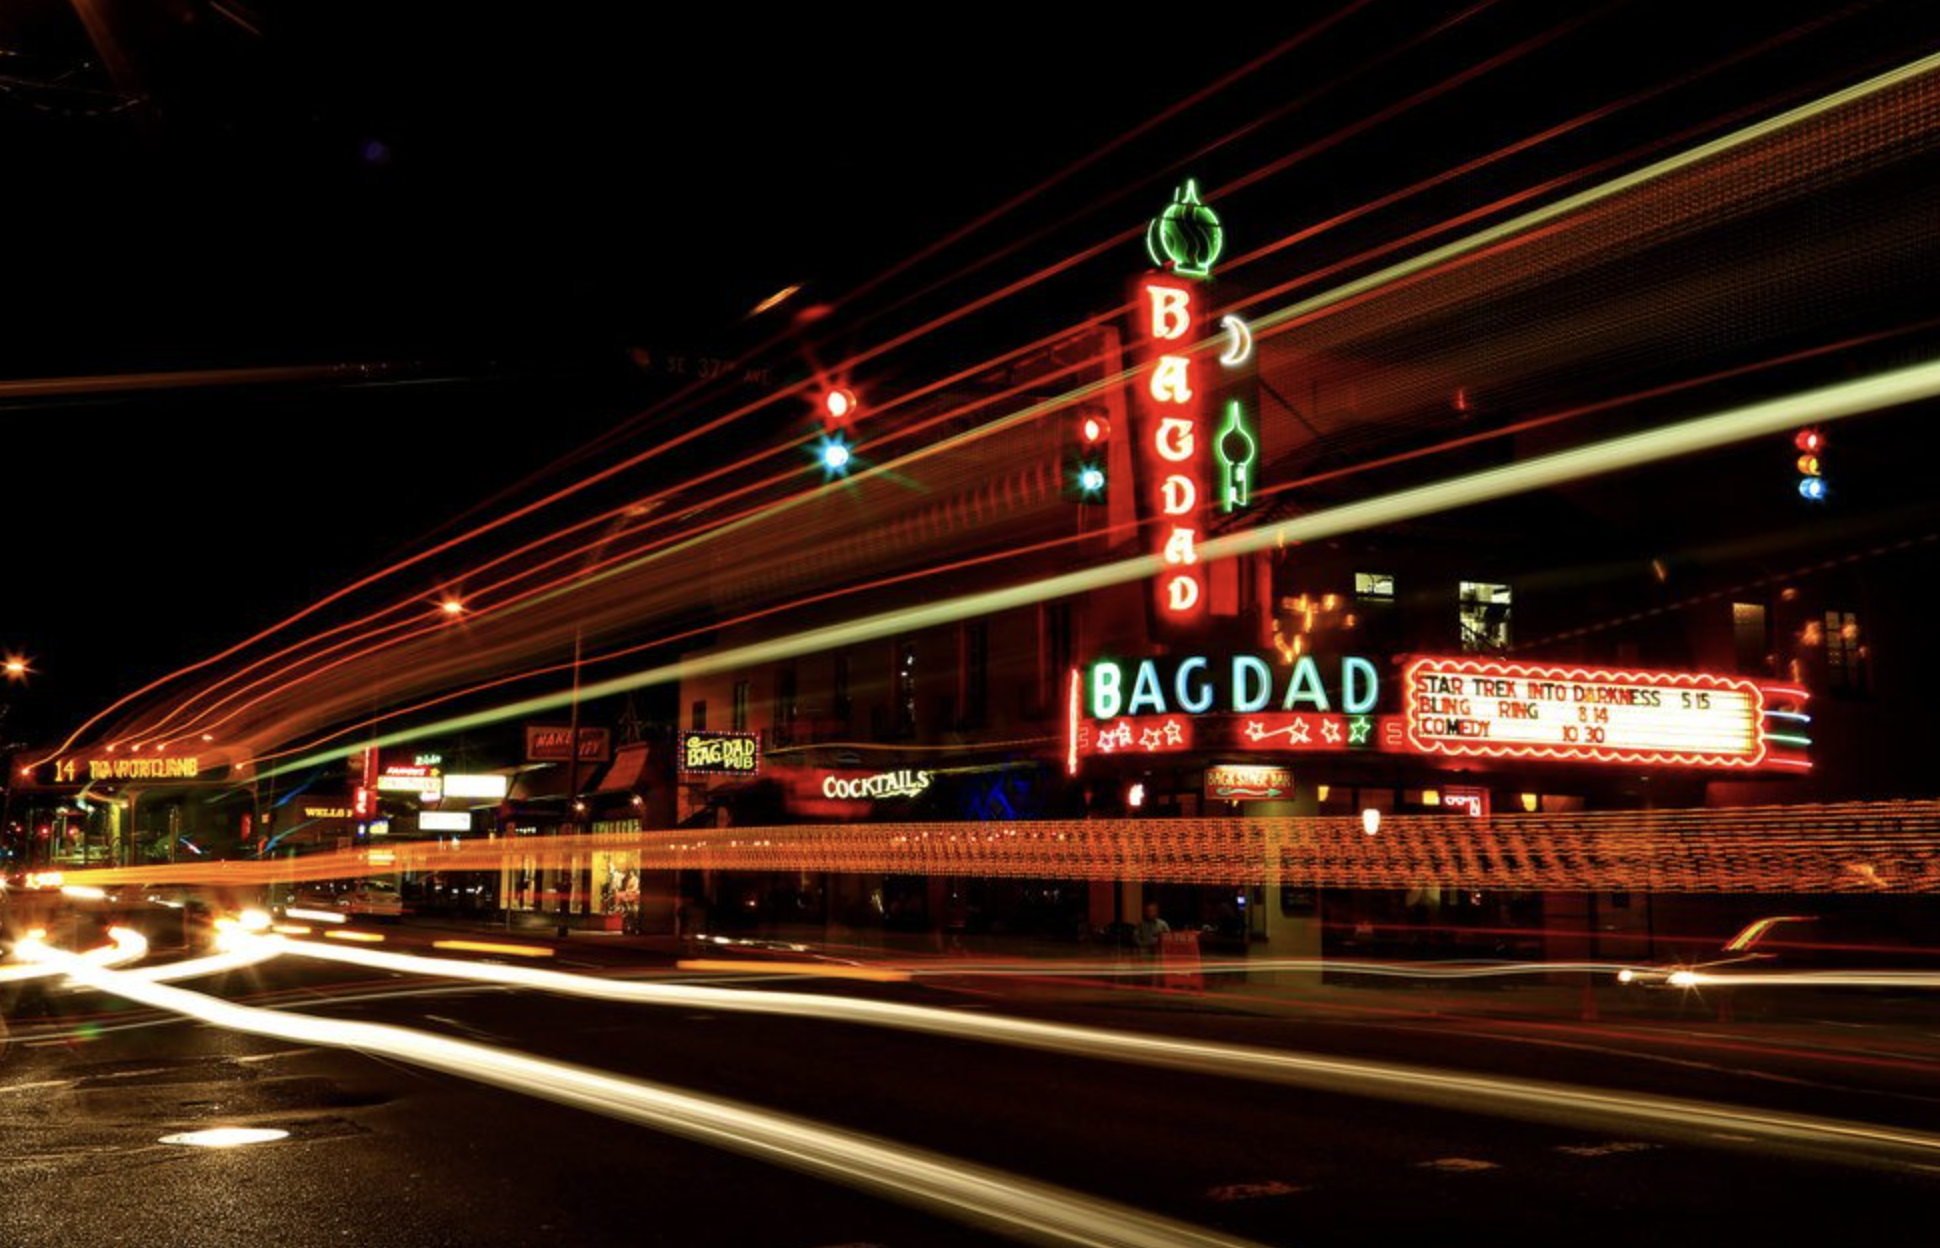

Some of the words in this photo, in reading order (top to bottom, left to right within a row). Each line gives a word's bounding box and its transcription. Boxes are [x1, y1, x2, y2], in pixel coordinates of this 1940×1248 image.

[1145, 285, 1199, 610] BAGDAD
[1092, 656, 1380, 719] BAGDAD
[1416, 675, 1464, 695] STAR
[1472, 678, 1517, 698] TREK
[1527, 681, 1567, 702] INTO
[1573, 685, 1661, 707] DARKNESS
[1681, 691, 1692, 709] 5
[1695, 692, 1711, 710] 15
[1419, 694, 1471, 715] BLING
[1498, 700, 1539, 719] RING
[1578, 706, 1588, 722] 8
[1593, 706, 1609, 724] 14
[1420, 716, 1491, 738] COMEDY
[1562, 725, 1579, 742] 10
[1584, 726, 1605, 744] 30
[687, 738, 755, 767] BAGDAD
[724, 756, 754, 769] PUB
[54, 759, 76, 782] 14
[822, 769, 931, 798] COCKTAILS
[304, 807, 345, 818] WELLS
